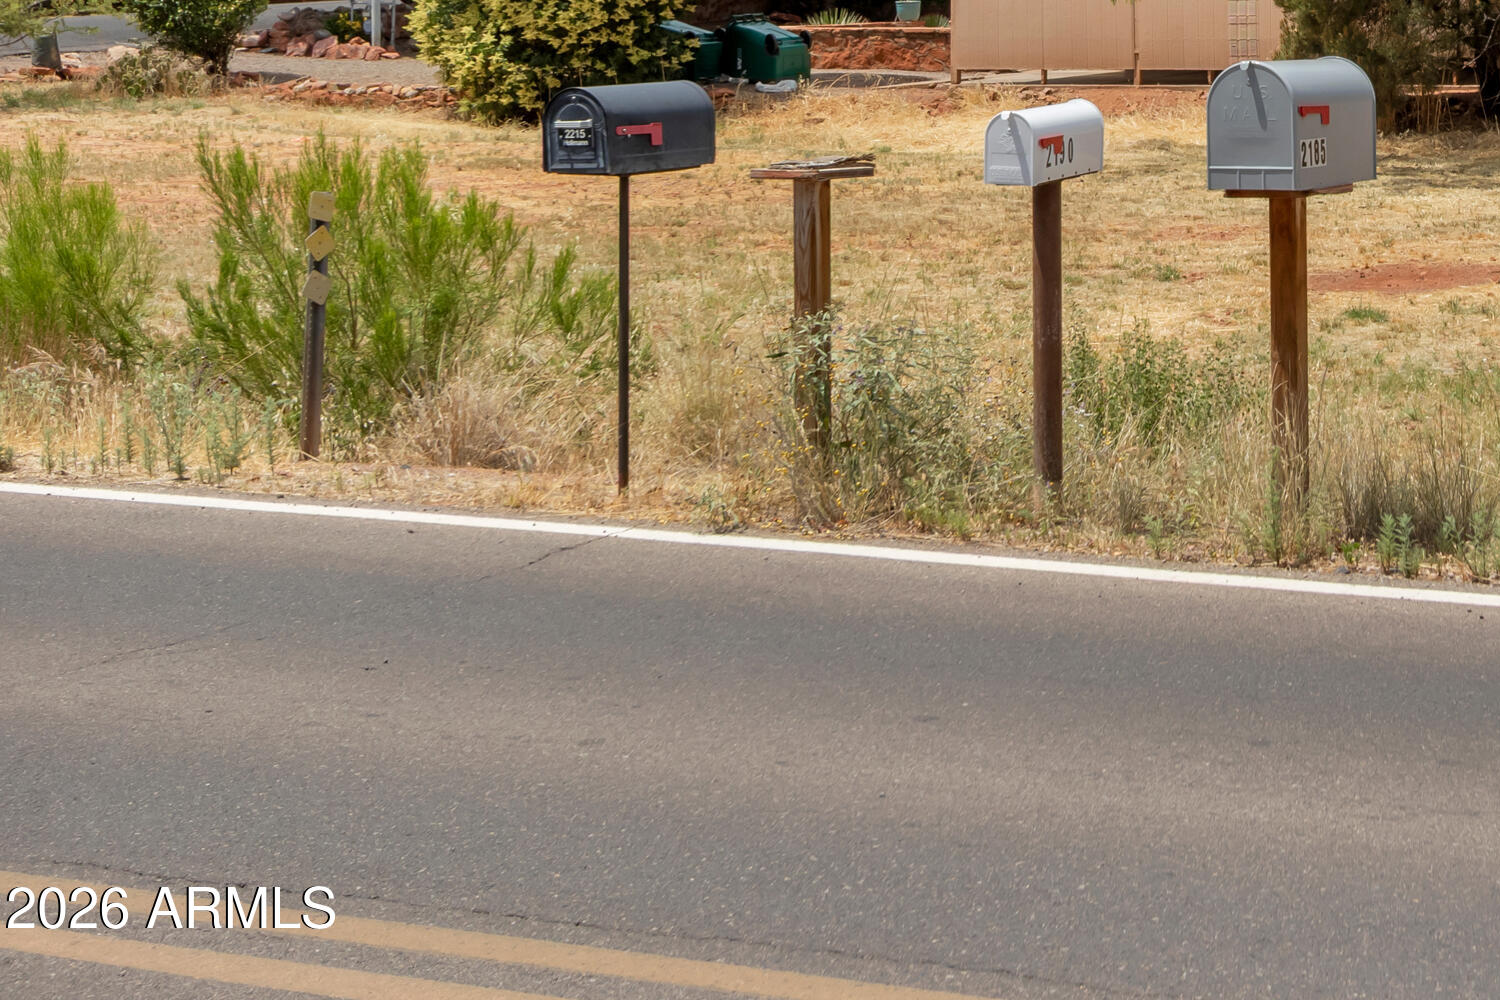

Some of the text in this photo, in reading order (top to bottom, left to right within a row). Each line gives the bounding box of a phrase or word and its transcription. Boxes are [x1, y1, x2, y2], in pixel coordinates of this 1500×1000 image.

[1223, 103, 1277, 121] MAL
[564, 128, 586, 139] 2215
[1301, 139, 1326, 167] 2185
